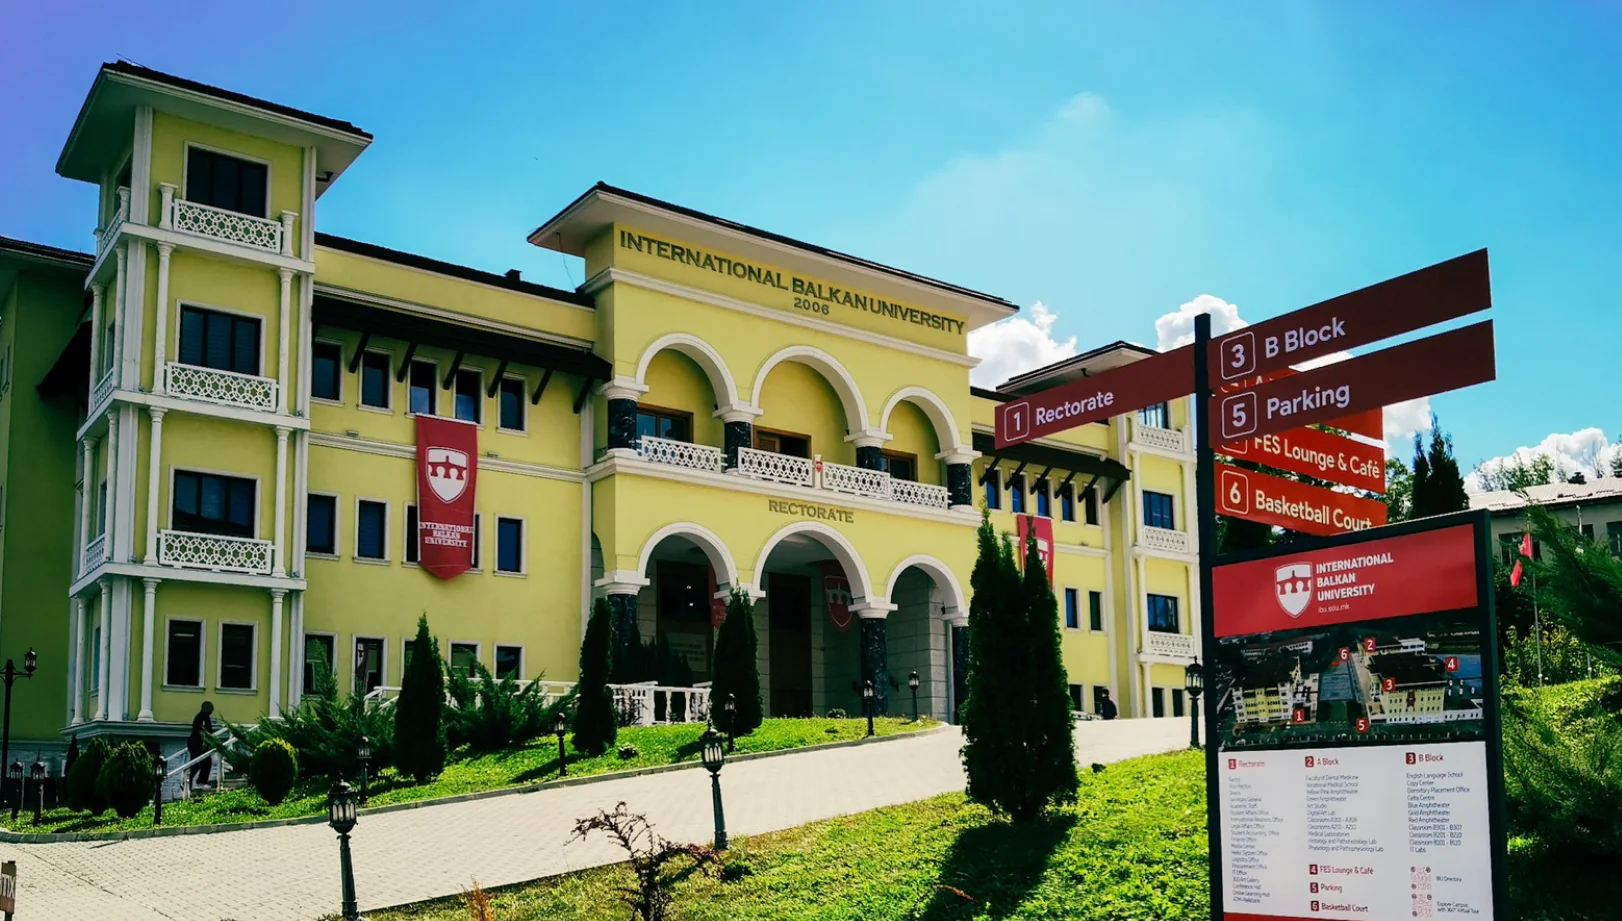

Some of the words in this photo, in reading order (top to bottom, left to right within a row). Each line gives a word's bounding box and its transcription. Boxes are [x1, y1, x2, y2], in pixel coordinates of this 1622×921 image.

[620, 230, 789, 290] INTERNATIONAL
[792, 277, 868, 311] BALKAN
[870, 299, 965, 335] UNIVERSITY
[793, 297, 830, 316] 2006
[1231, 344, 1245, 368] 3
[1265, 336, 1279, 358] B
[1285, 317, 1346, 353] Block
[1013, 412, 1021, 431] 1
[1036, 391, 1114, 426] Rectorate
[1232, 402, 1247, 427] 5
[1267, 384, 1350, 419] Parking
[1285, 438, 1335, 471] Lounge
[1338, 455, 1347, 471] &
[1350, 456, 1380, 478] Café
[768, 499, 854, 523] RECTORATE
[1230, 482, 1241, 504] 6
[1255, 489, 1329, 525] Basketball
[1333, 510, 1371, 530] Court
[1316, 552, 1394, 574] INTERNATIONAL
[1316, 573, 1356, 588] BALKAN
[1317, 584, 1375, 601] UNIVERSITY
[1322, 758, 1339, 766] Block
[1418, 754, 1424, 762] B
[1425, 754, 1444, 762] Block
[1320, 865, 1331, 873] FES
[1332, 866, 1353, 876] Lounge
[1360, 867, 1374, 875] Café
[1321, 883, 1343, 893] Parking
[1322, 902, 1351, 911] Basketball
[1352, 904, 1369, 912] Court
